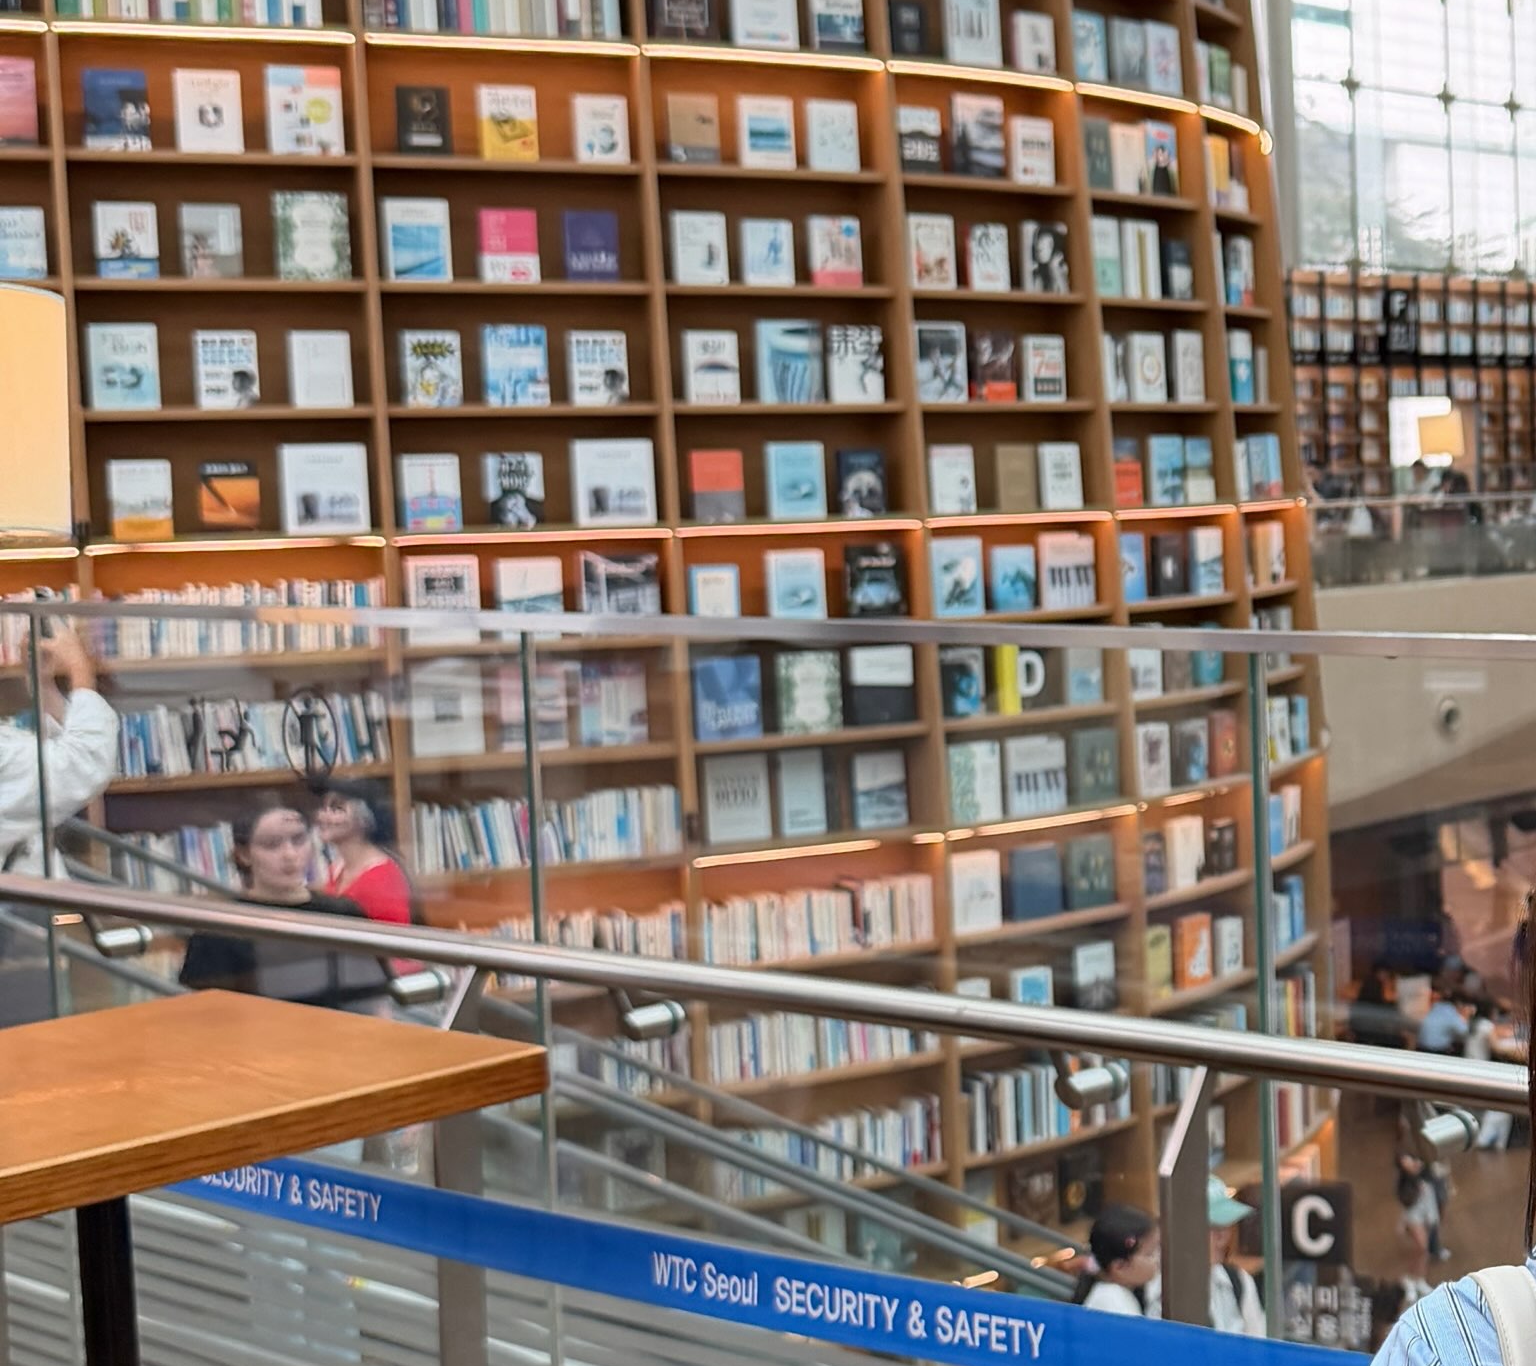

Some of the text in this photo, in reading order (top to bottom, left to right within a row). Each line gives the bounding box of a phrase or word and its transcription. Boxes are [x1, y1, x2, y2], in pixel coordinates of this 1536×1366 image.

[1017, 650, 1045, 697] D
[290, 1174, 303, 1205] &
[309, 1178, 382, 1222] SAFETY
[1291, 1193, 1336, 1258] C
[652, 1251, 1046, 1359] WTC Seoul SECURITY & SAFETY
